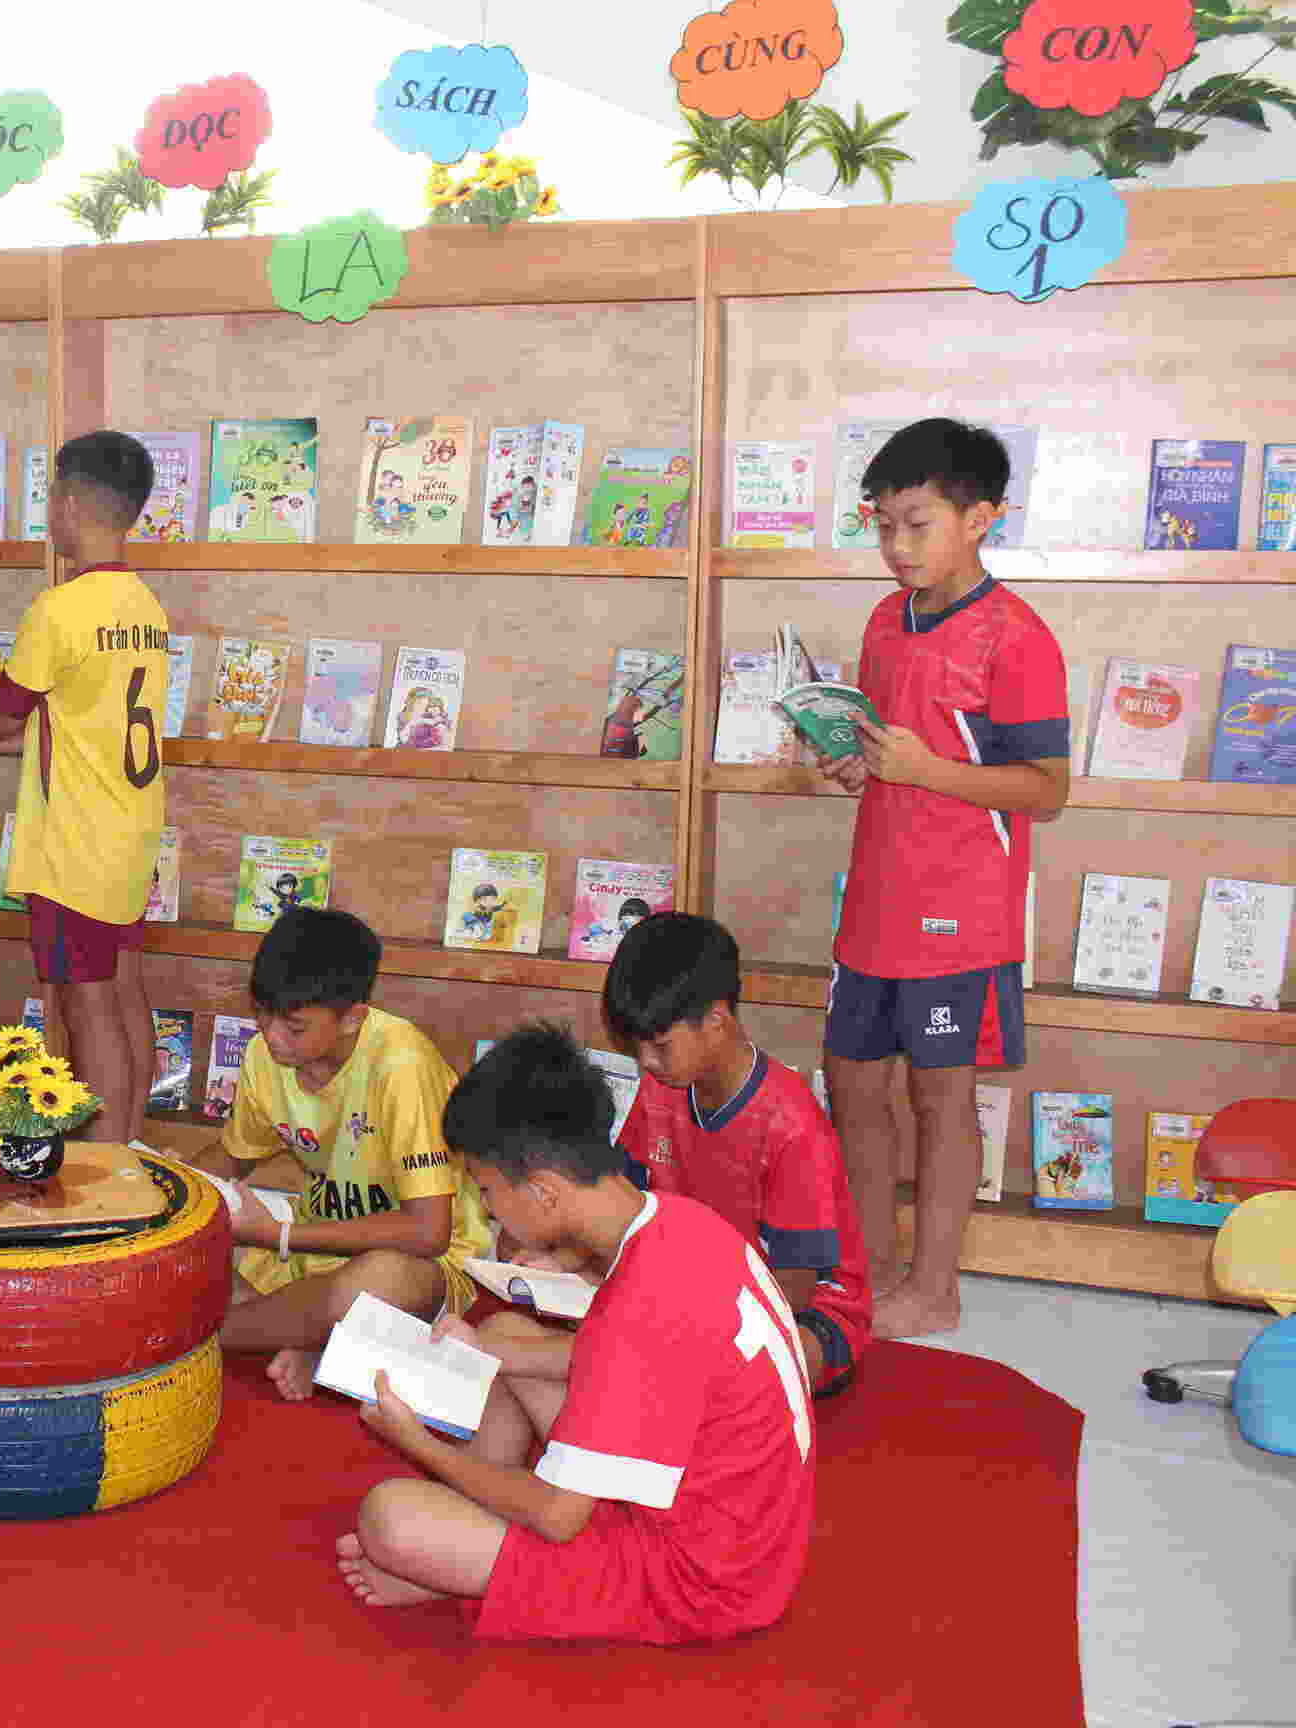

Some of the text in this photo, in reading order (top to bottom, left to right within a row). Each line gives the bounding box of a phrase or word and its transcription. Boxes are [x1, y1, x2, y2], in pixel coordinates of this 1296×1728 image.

[695, 29, 806, 75] CÙNG
[1041, 23, 1153, 64] CON
[394, 76, 498, 118] SÁCH
[162, 108, 243, 153] ĐỌC
[1014, 243, 1057, 300] 1
[123, 666, 160, 789] 6
[400, 1151, 449, 1170] YAMAH
